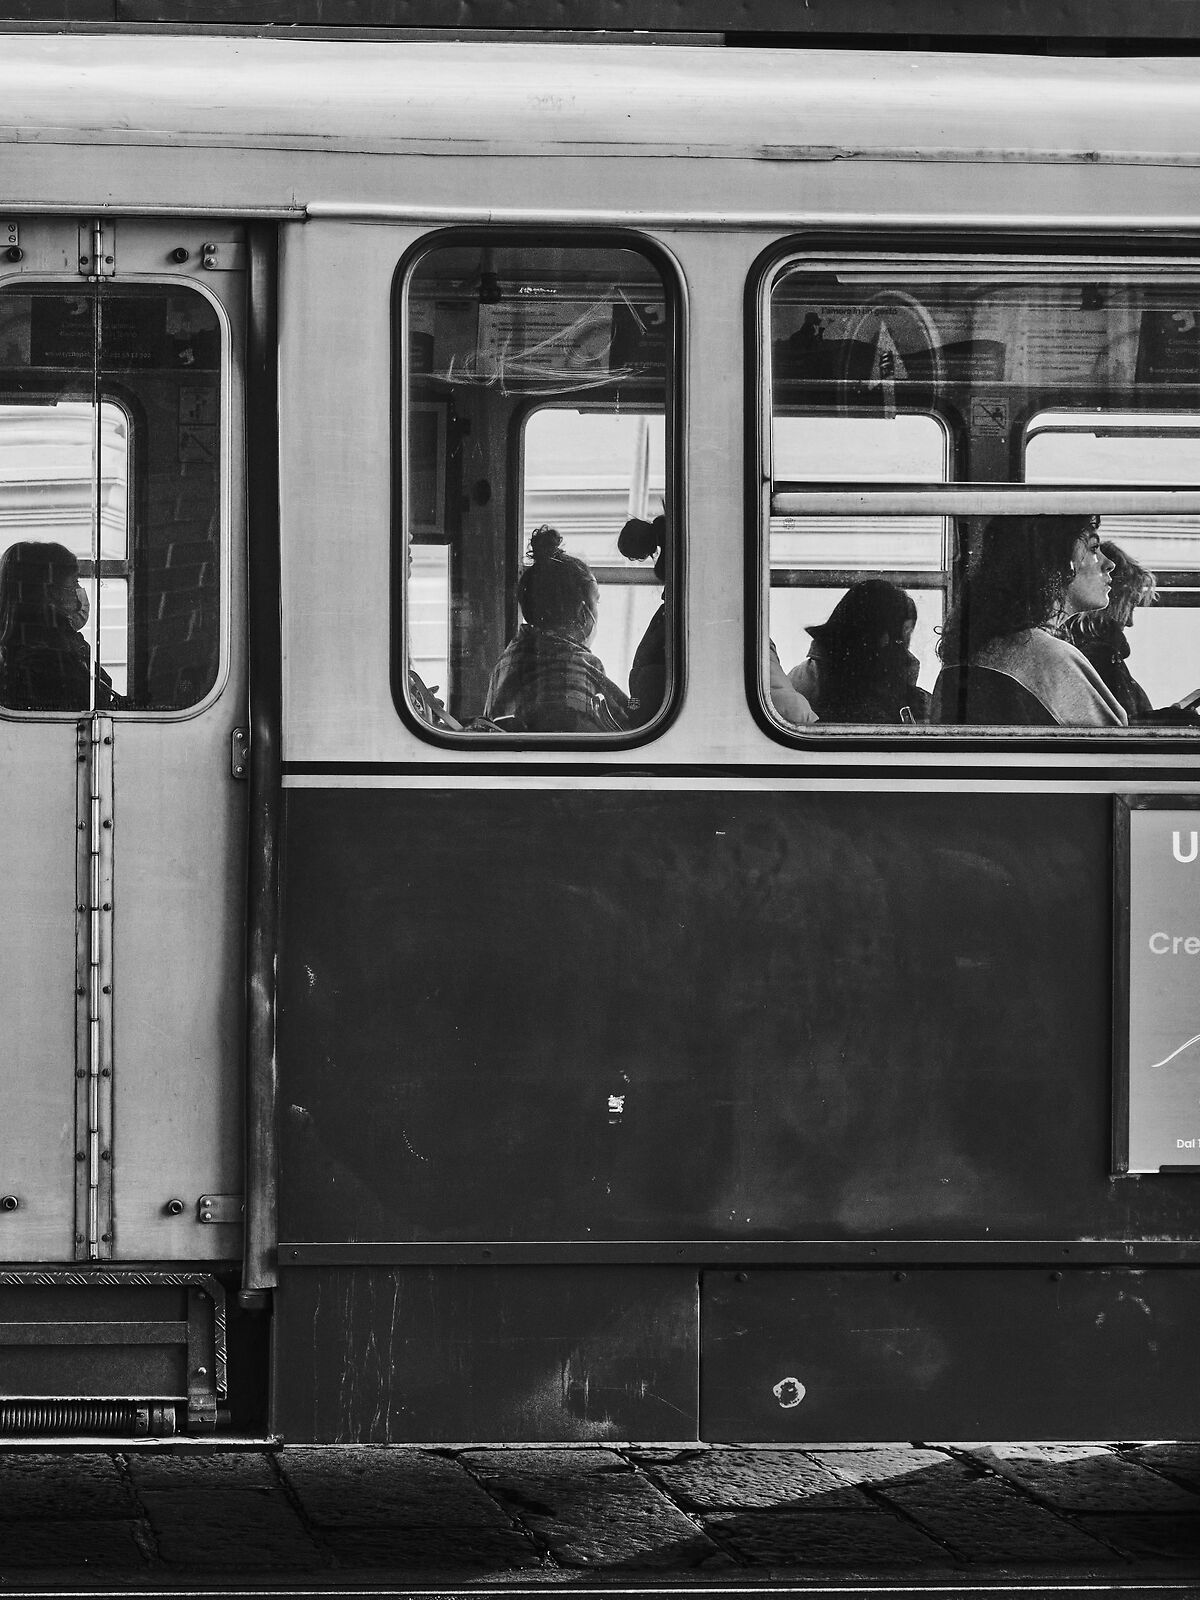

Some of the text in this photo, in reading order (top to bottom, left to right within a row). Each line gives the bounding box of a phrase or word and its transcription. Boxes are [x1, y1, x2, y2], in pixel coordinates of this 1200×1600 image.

[1172, 831, 1198, 863] U
[1149, 931, 1200, 955] Cre
[1176, 1138, 1195, 1148] Dal
